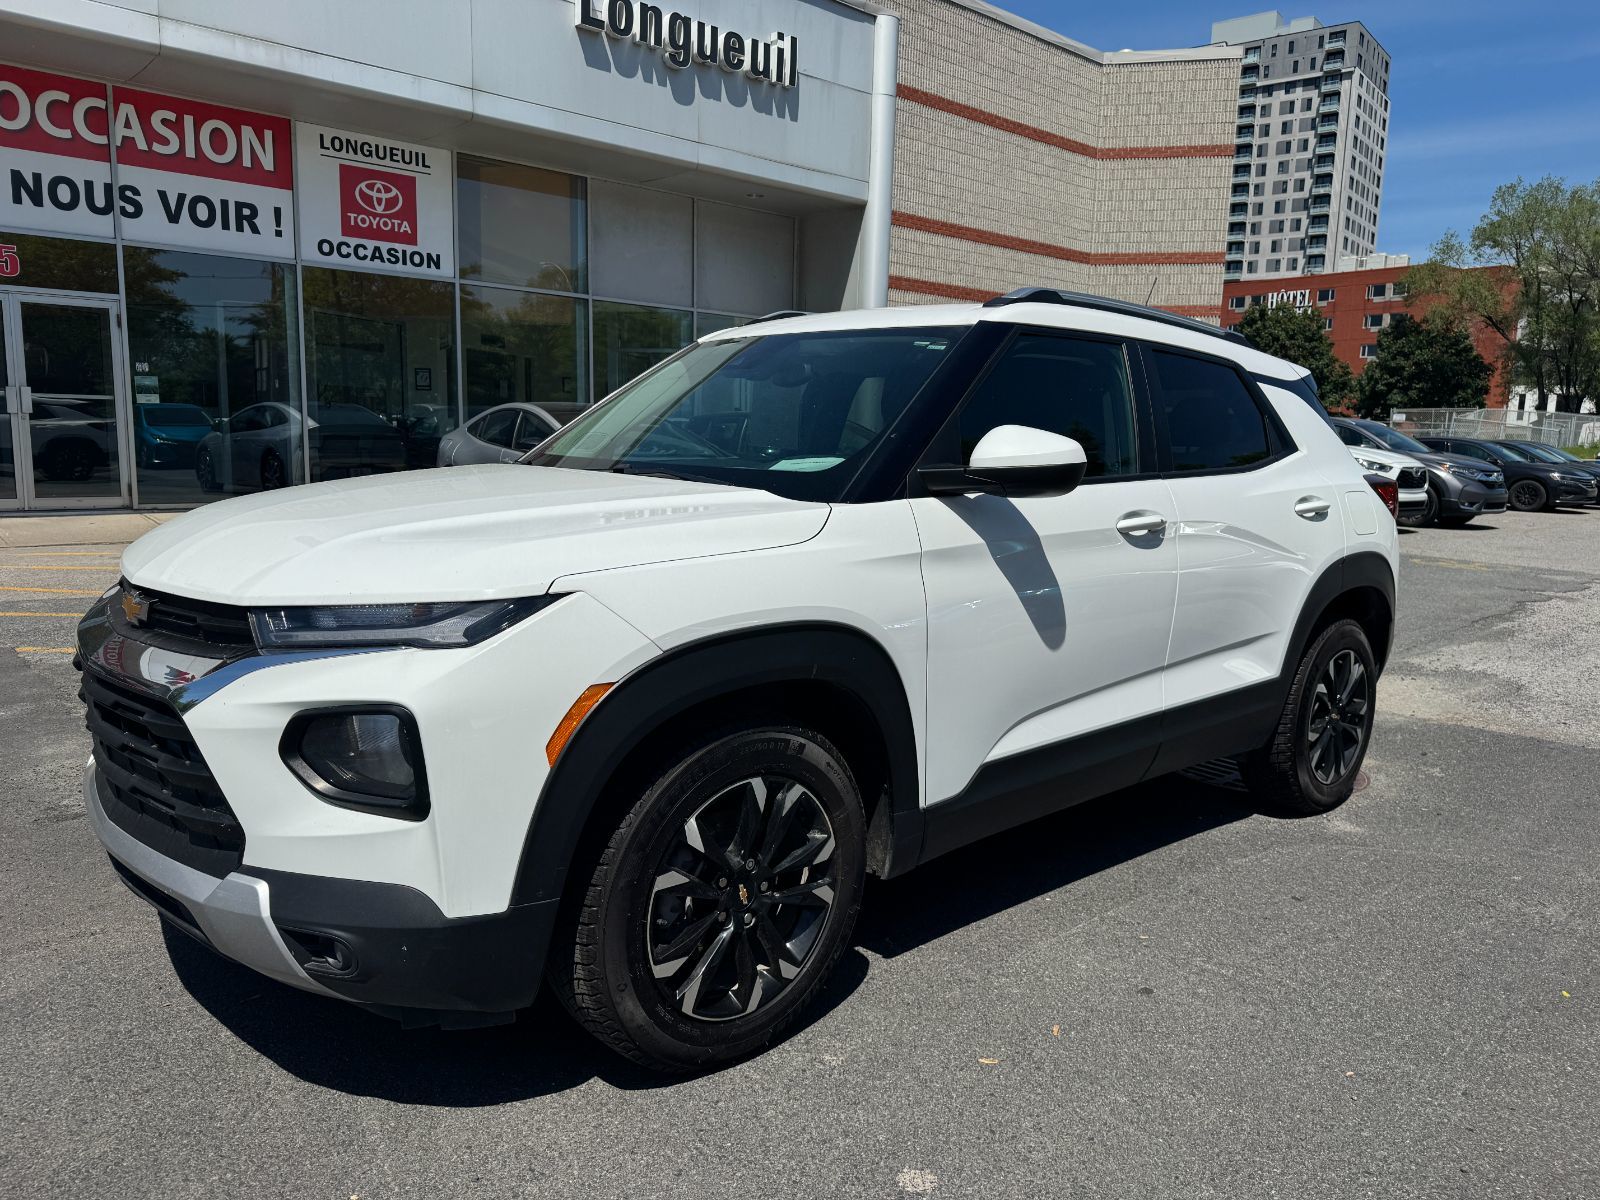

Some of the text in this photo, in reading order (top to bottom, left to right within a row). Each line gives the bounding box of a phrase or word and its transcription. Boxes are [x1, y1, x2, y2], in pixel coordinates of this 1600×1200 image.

[0, 80, 274, 172] OCCASION
[319, 133, 431, 169] LONGUEUIL
[10, 168, 143, 219] NOUS
[157, 189, 261, 236] VOIR
[347, 212, 412, 234] TOYOTA
[0, 243, 20, 277] 5
[317, 238, 441, 270] OCCASION
[1267, 289, 1313, 310] HÔTEL
